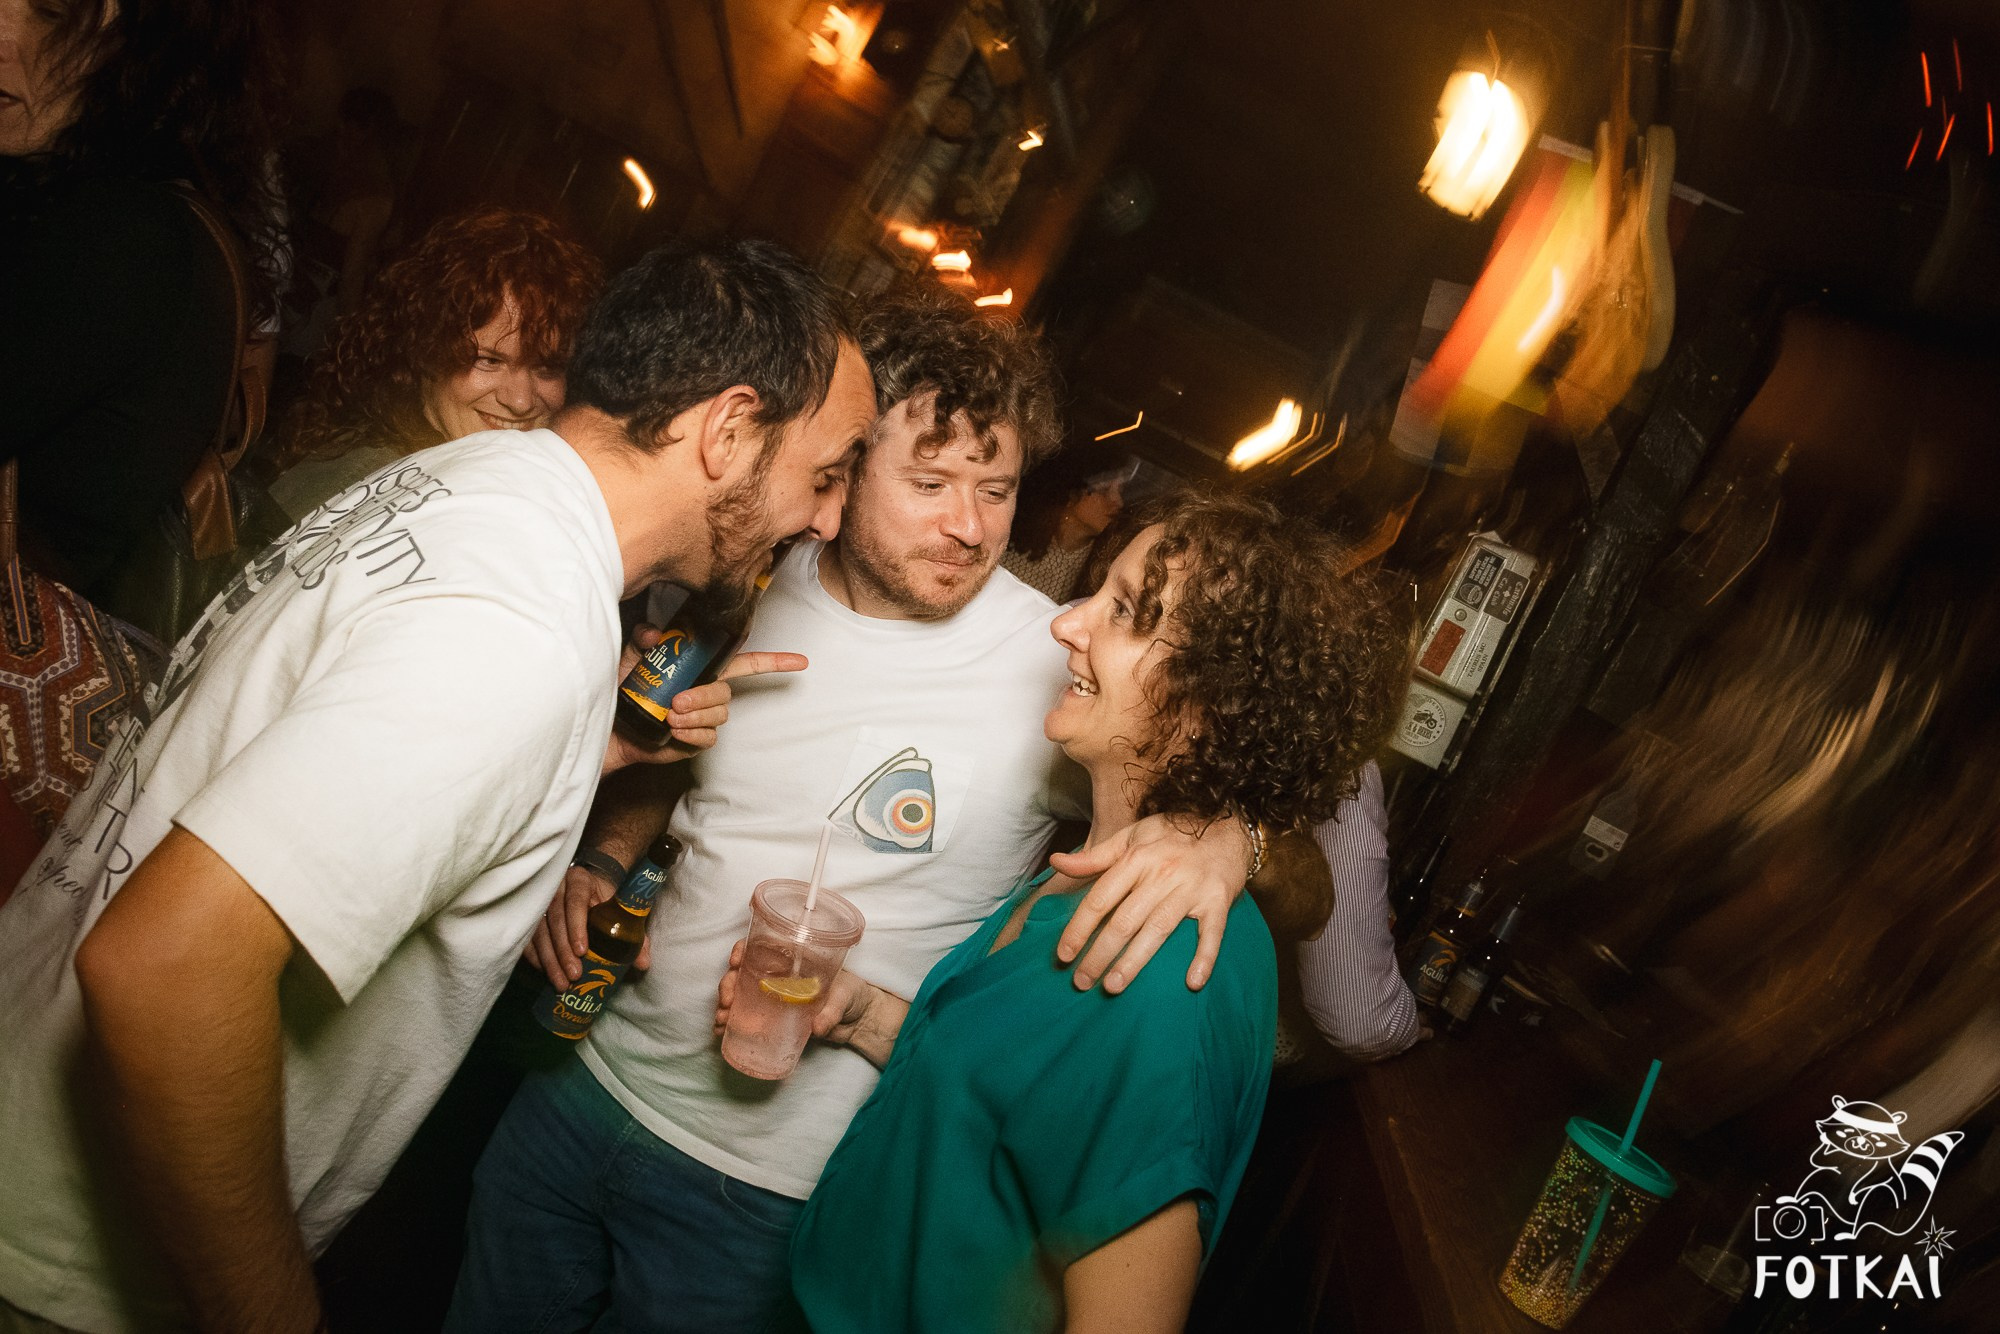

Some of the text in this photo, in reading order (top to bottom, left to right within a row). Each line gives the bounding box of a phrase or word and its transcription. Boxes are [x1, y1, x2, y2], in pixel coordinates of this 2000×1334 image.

[659, 644, 668, 655] EL
[1467, 654, 1481, 677] TAURUS
[1478, 653, 1488, 672] SPAIN
